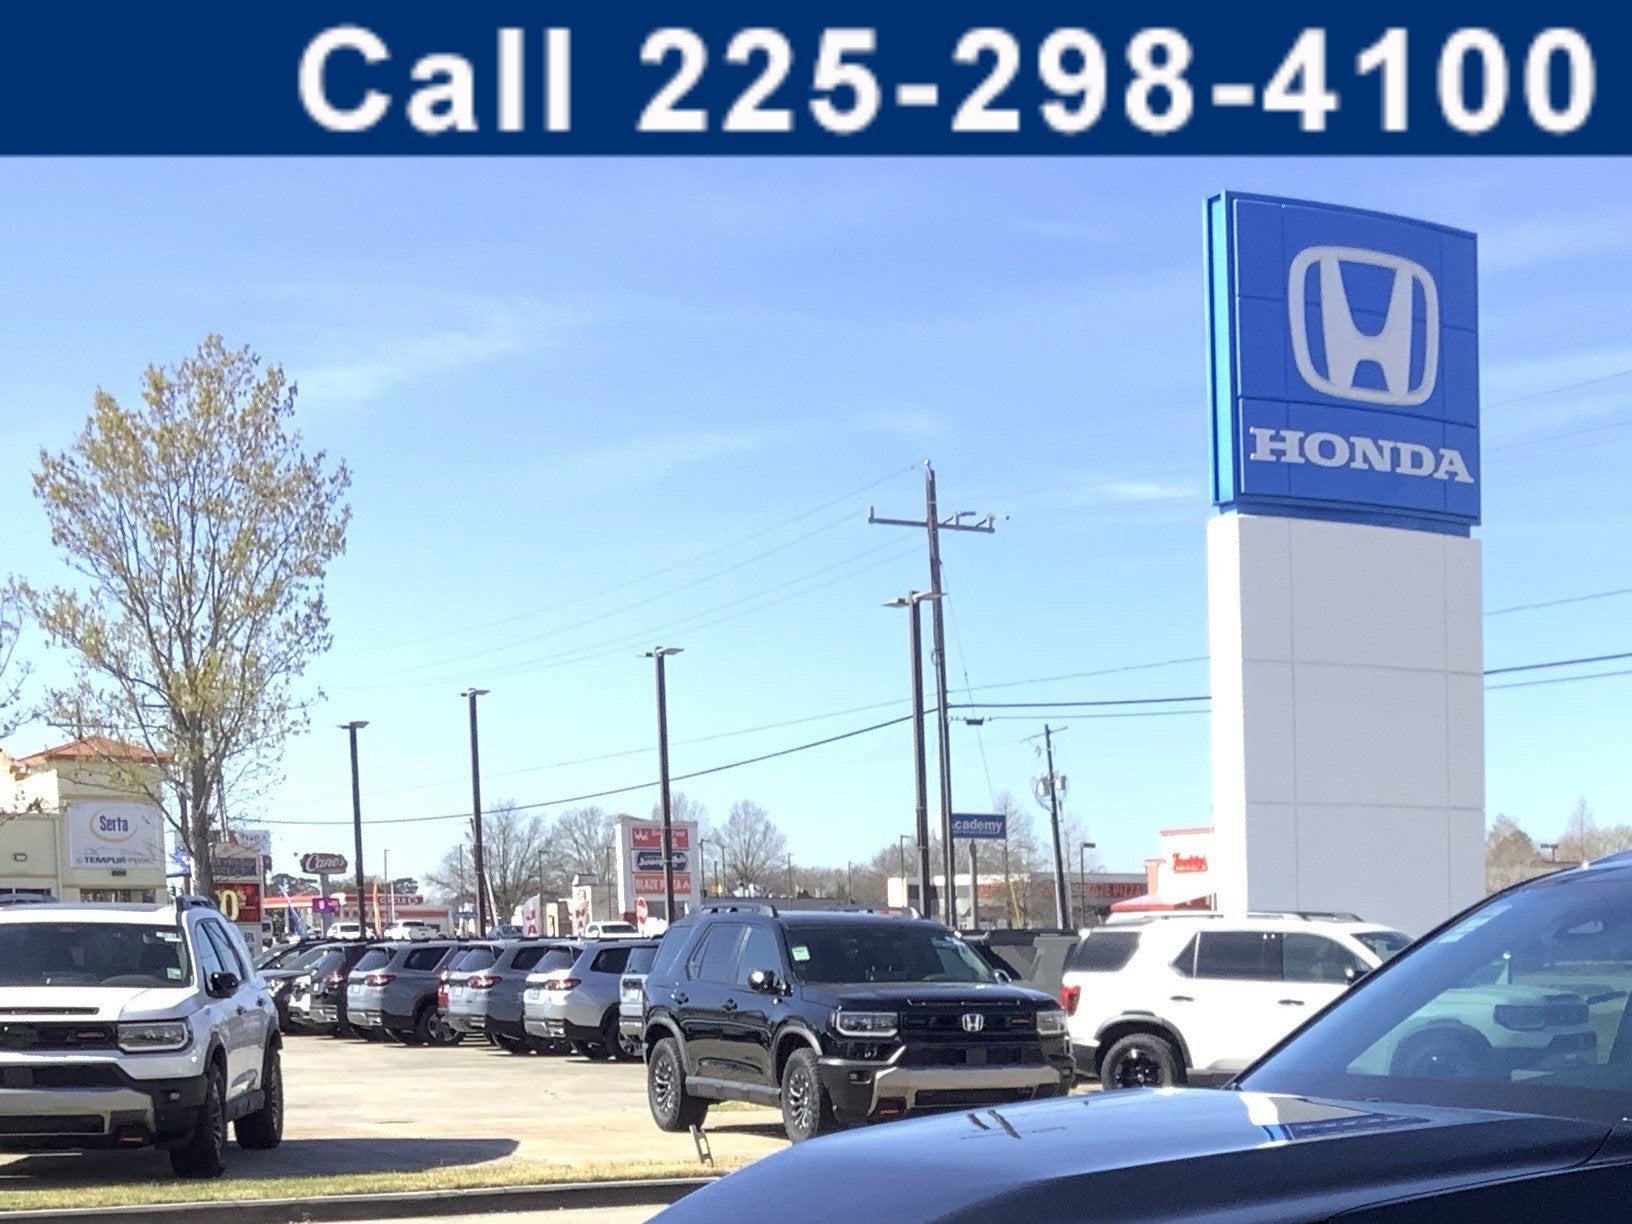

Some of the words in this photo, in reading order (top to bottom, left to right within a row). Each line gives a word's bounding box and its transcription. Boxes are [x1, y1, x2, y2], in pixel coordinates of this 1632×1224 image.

[1250, 426, 1474, 484] HONDA
[99, 815, 129, 832] Serta
[952, 818, 1003, 834] cademy
